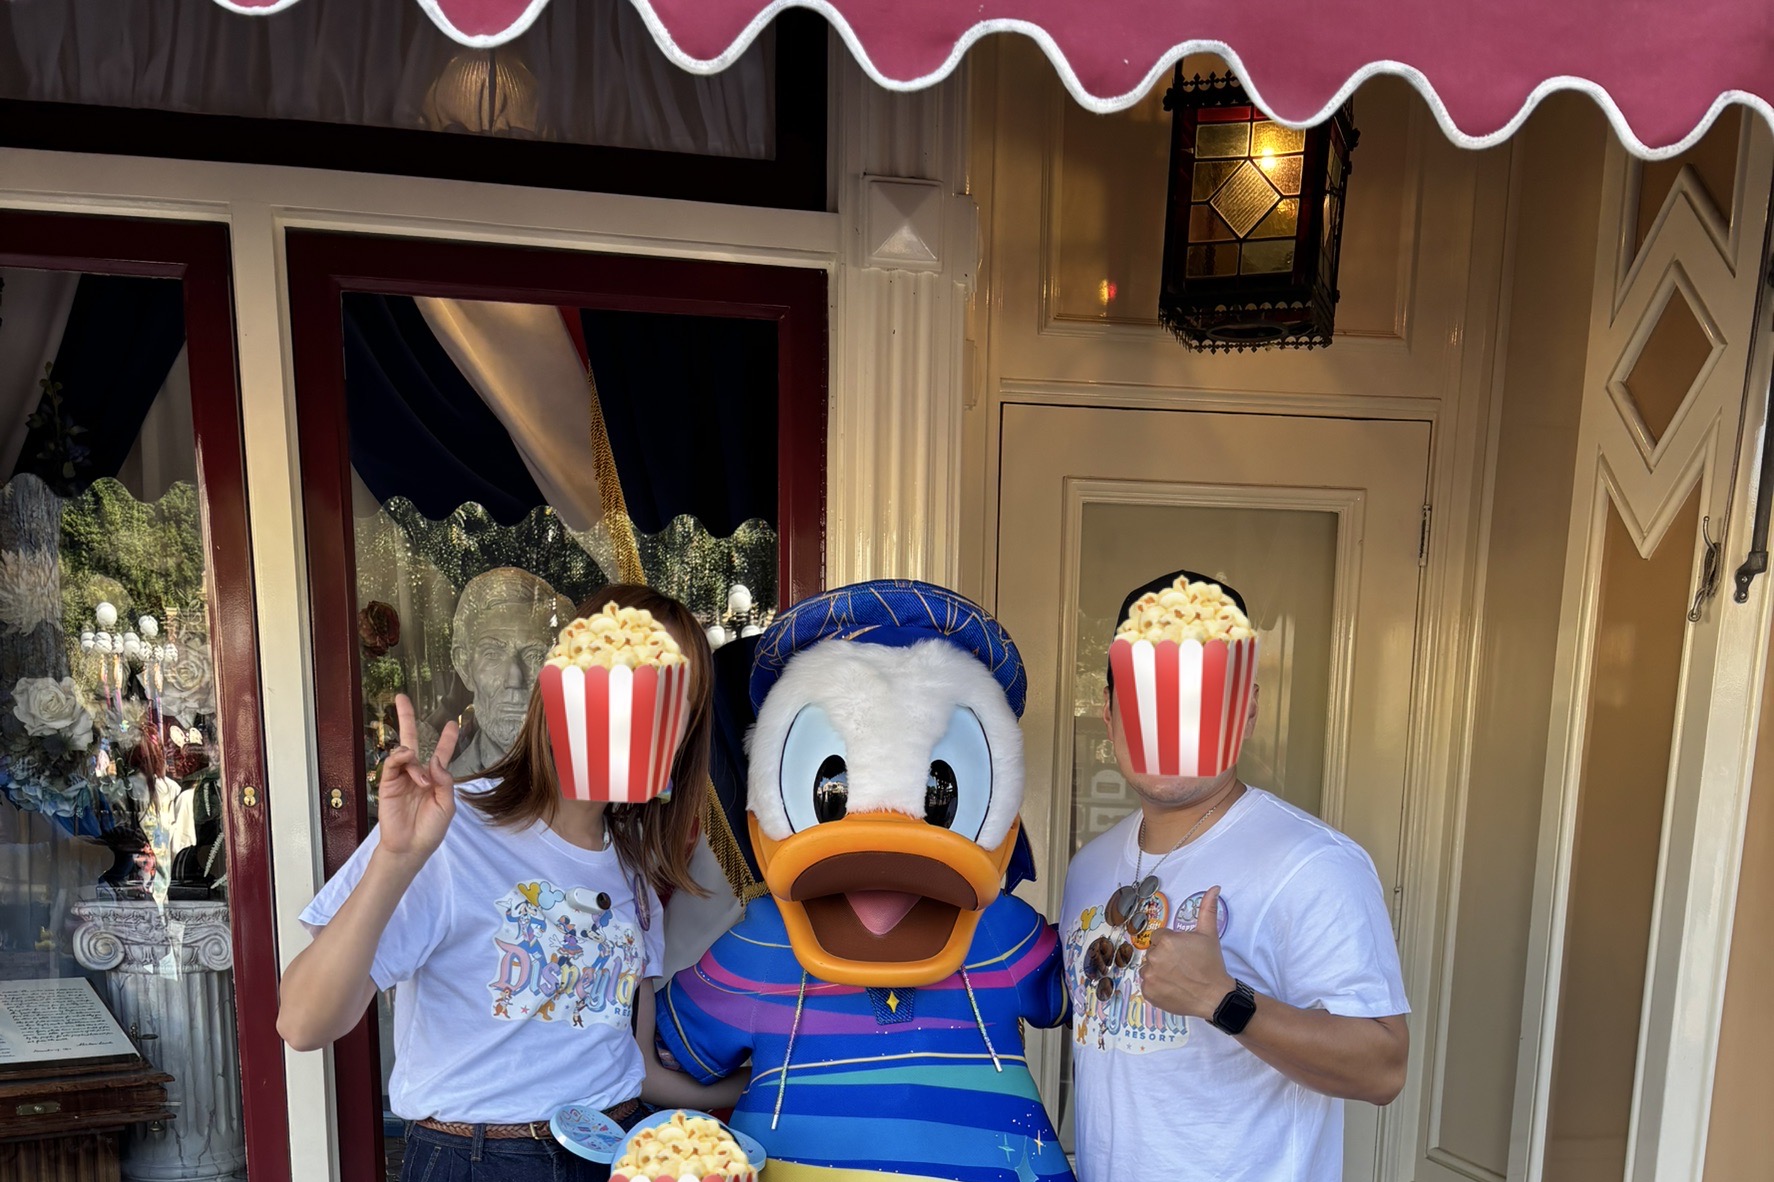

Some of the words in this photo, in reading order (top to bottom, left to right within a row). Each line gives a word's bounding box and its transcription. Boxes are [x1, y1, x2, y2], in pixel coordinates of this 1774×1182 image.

[1176, 922, 1197, 932] Happ
[489, 937, 637, 1013] Disneyla
[1124, 1029, 1176, 1043] RESORT
